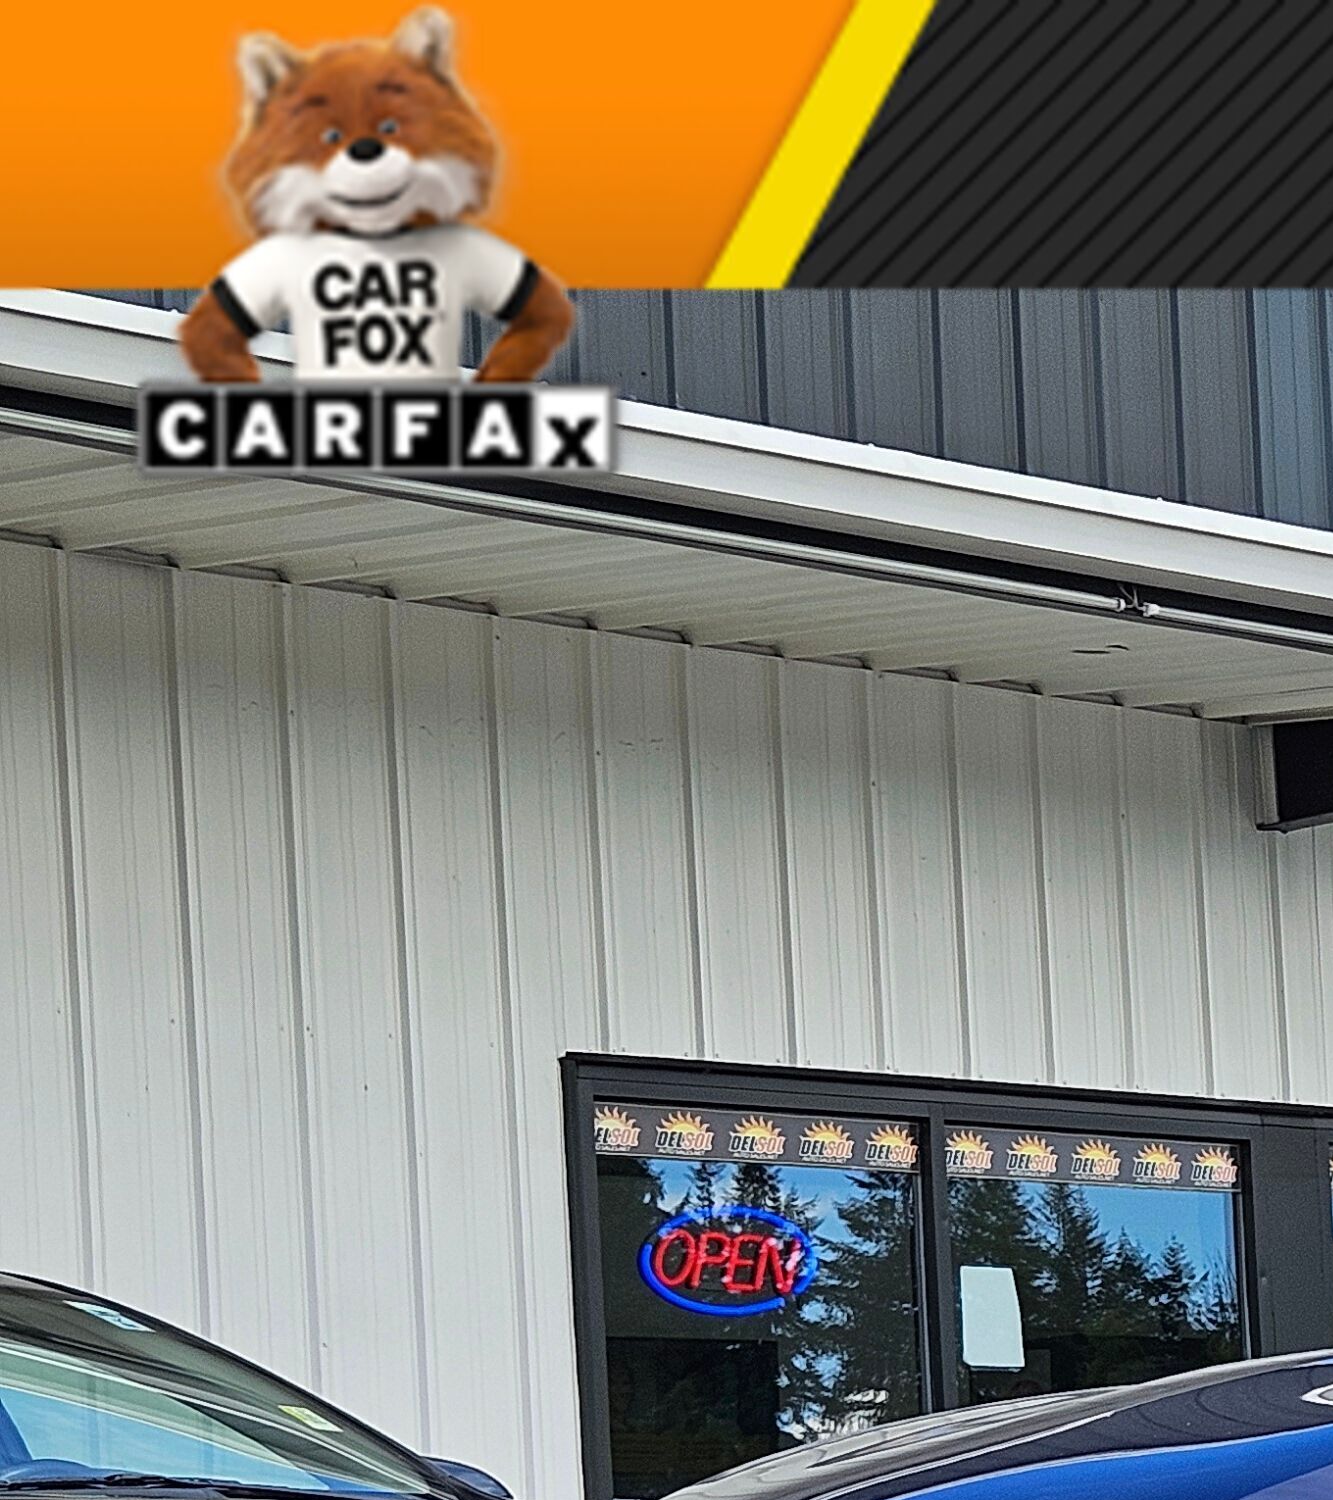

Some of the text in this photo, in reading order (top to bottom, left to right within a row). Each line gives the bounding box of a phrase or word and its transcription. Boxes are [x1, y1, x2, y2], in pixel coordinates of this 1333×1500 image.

[656, 1130, 713, 1151] DELSOL
[730, 1134, 786, 1156] DELSOL
[799, 1138, 855, 1160] DELSOL
[865, 1142, 918, 1164] DELSOL
[1006, 1153, 1058, 1172] DELSOL
[1072, 1156, 1121, 1176] DELSOL
[1133, 1160, 1181, 1180] DELSOL
[1191, 1164, 1238, 1183] DELSOL
[654, 1228, 802, 1294] OPEN
